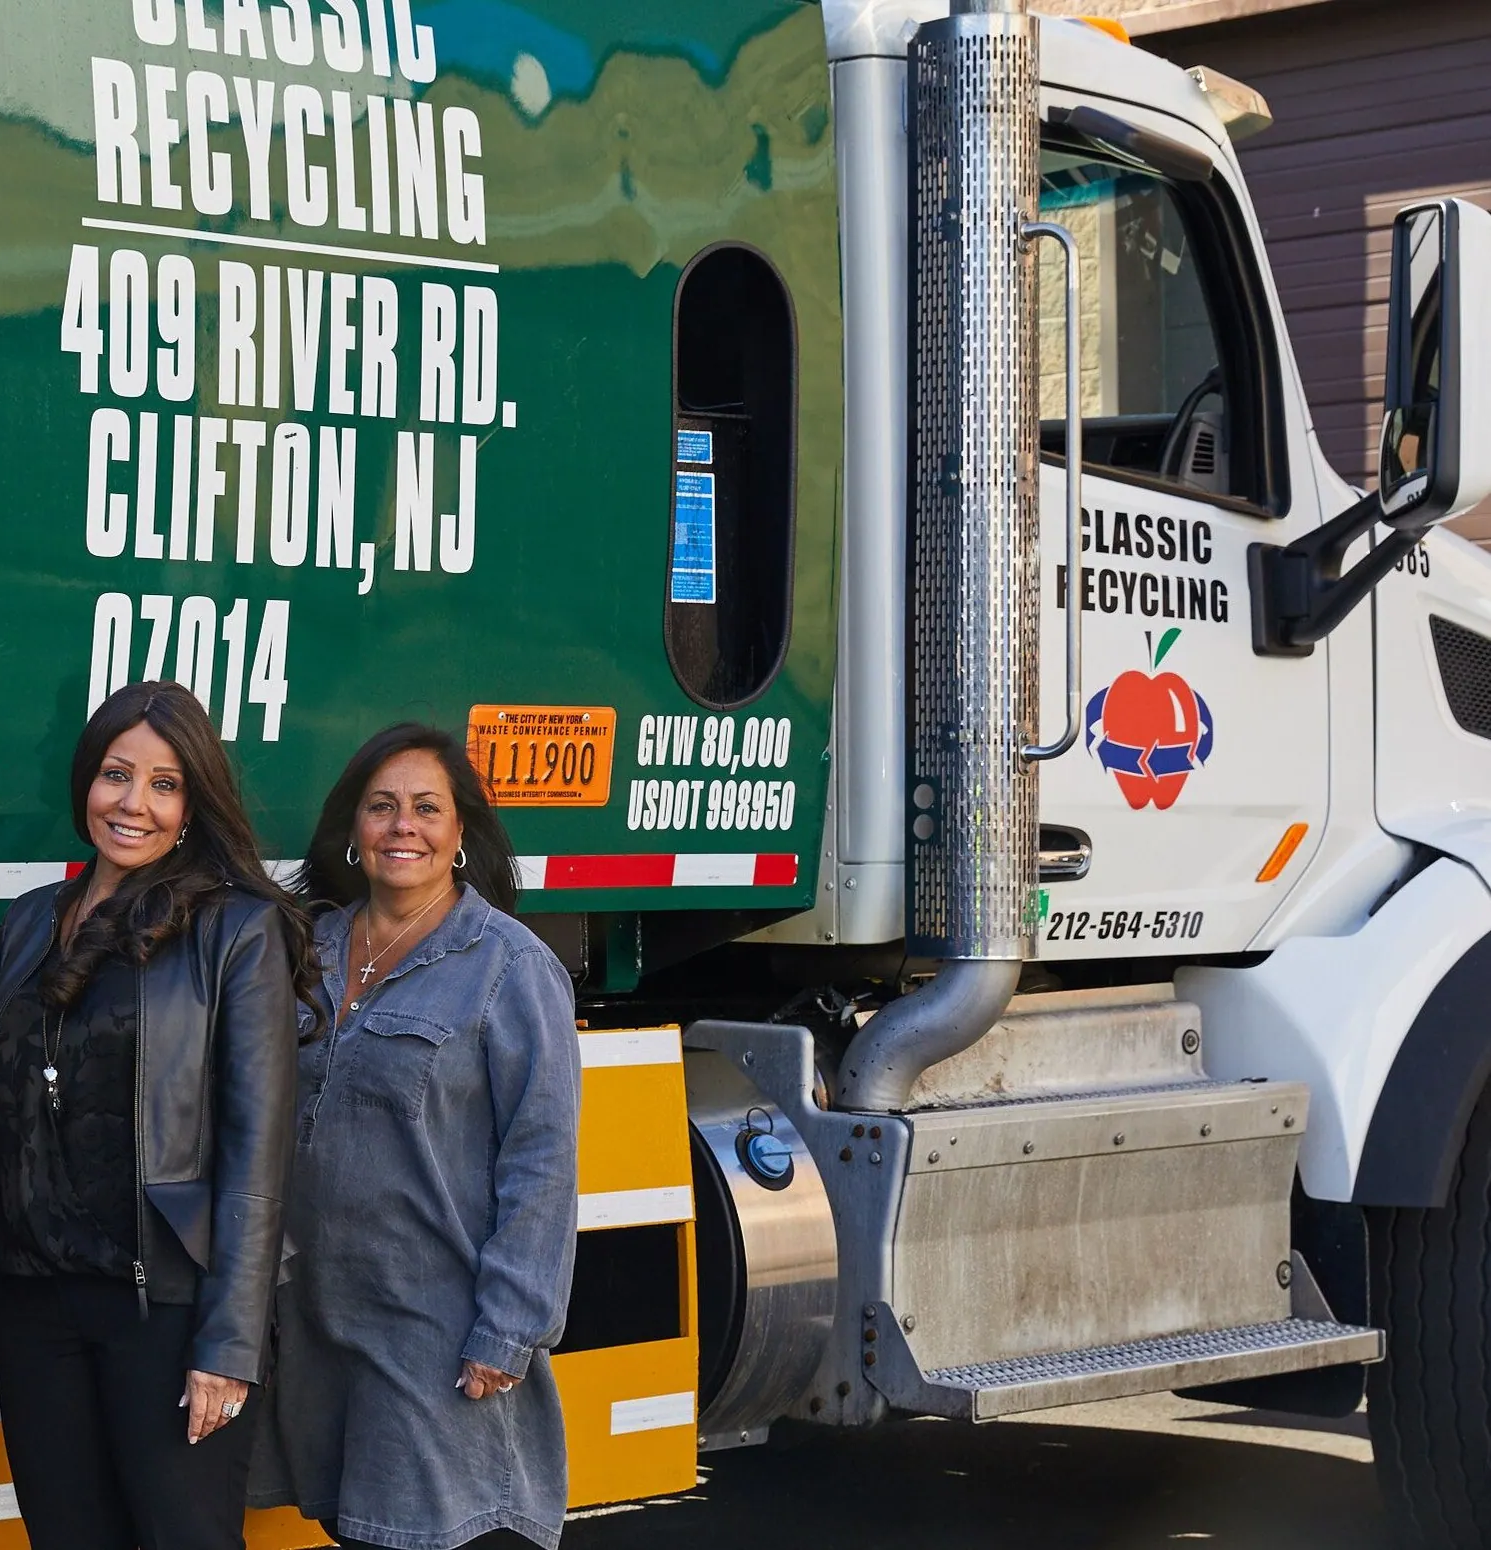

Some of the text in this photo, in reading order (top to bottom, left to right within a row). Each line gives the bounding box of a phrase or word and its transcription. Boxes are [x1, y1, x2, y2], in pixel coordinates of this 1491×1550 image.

[91, 56, 486, 246] RECYCLING
[61, 244, 517, 429] 409 RIVER RD.
[86, 407, 478, 595] CLIFTON, NJ
[86, 592, 290, 742] 07014
[478, 725, 608, 736] WASTE CONVEYANCE PERMIT
[505, 713, 583, 725] THE CITY OF NEW YORK
[637, 714, 792, 776] GVW 80,000
[488, 742, 595, 786] L11900
[627, 779, 796, 831] USDOT 998950
[1046, 911, 1204, 941] 212-564-5310
